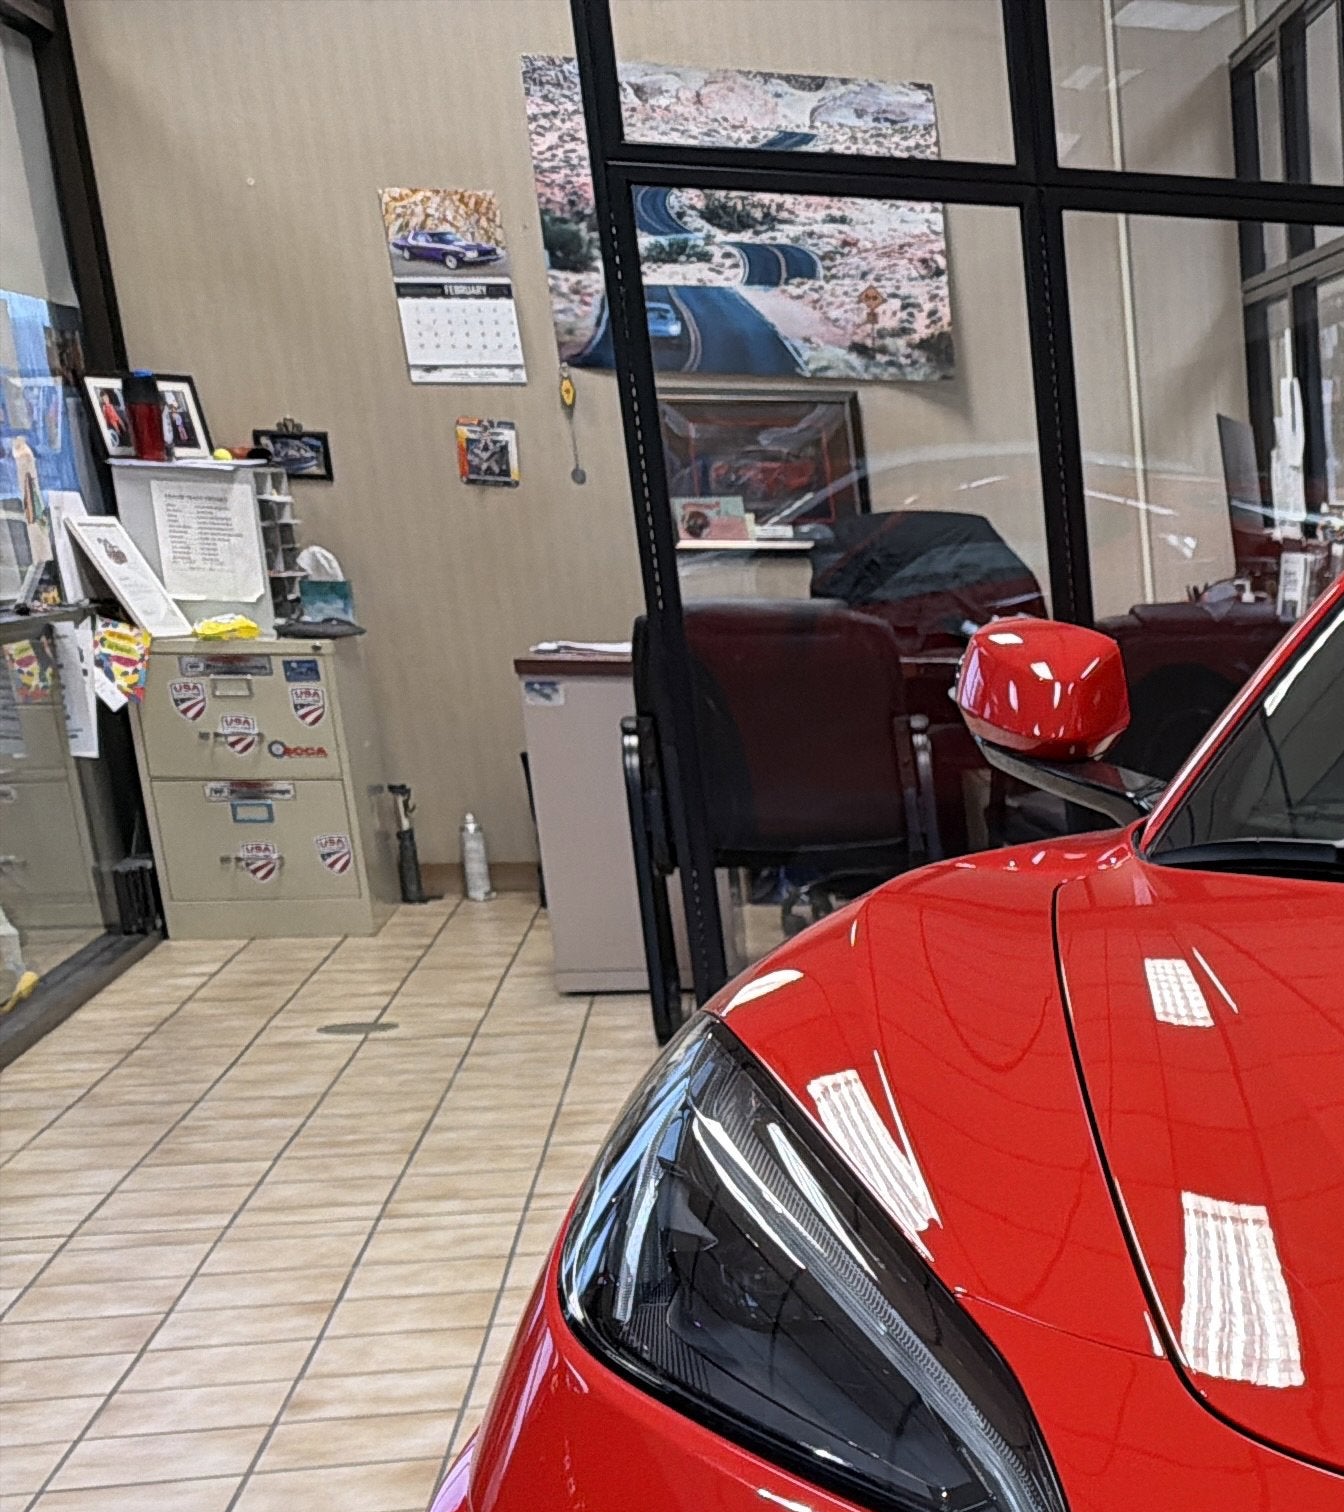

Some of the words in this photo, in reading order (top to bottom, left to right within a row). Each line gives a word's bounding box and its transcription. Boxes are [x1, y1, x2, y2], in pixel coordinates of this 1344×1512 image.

[174, 683, 200, 693] USA
[294, 688, 320, 699] USA
[225, 716, 251, 727] USA
[319, 837, 344, 848] USA
[245, 843, 271, 854] USA
